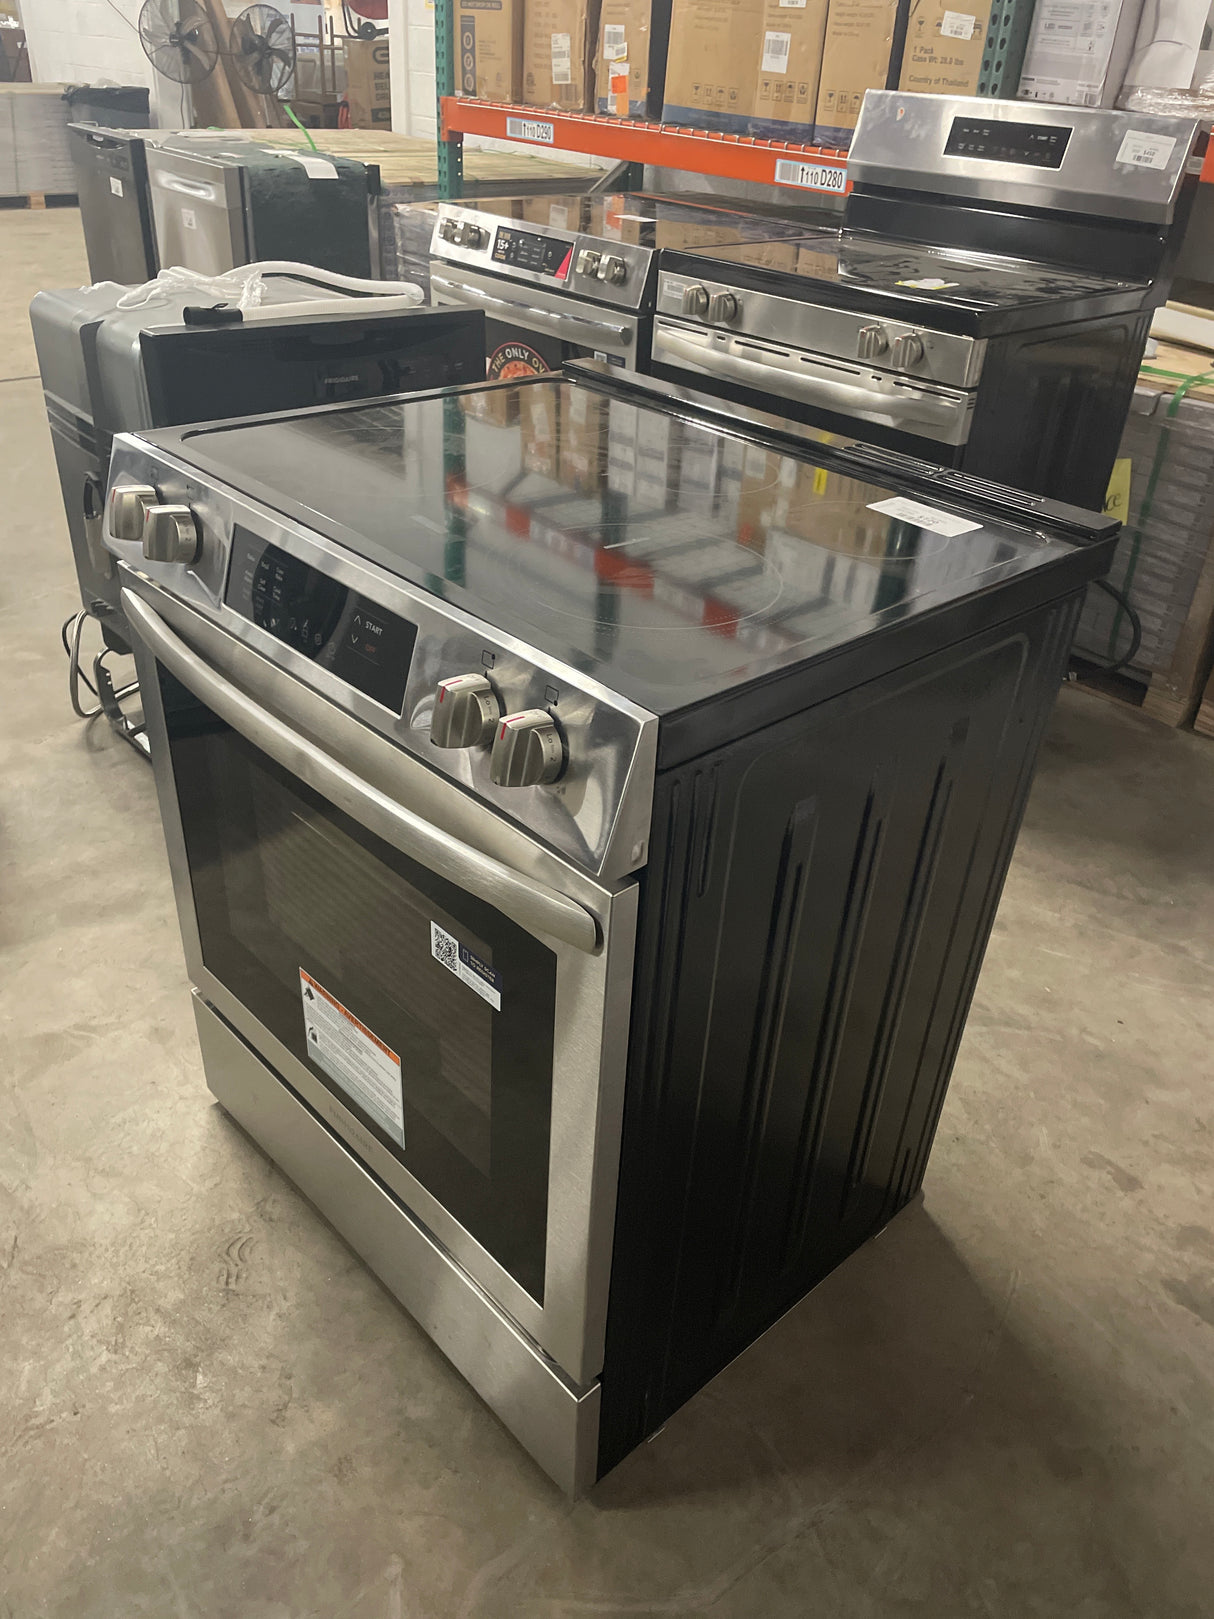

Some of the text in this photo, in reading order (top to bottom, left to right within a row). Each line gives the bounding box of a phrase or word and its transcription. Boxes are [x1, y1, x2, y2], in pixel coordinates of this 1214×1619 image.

[536, 124, 552, 140] D290
[820, 169, 843, 189] D280
[492, 353, 505, 373] THE
[505, 347, 529, 360] ONLY
[365, 621, 383, 636] START
